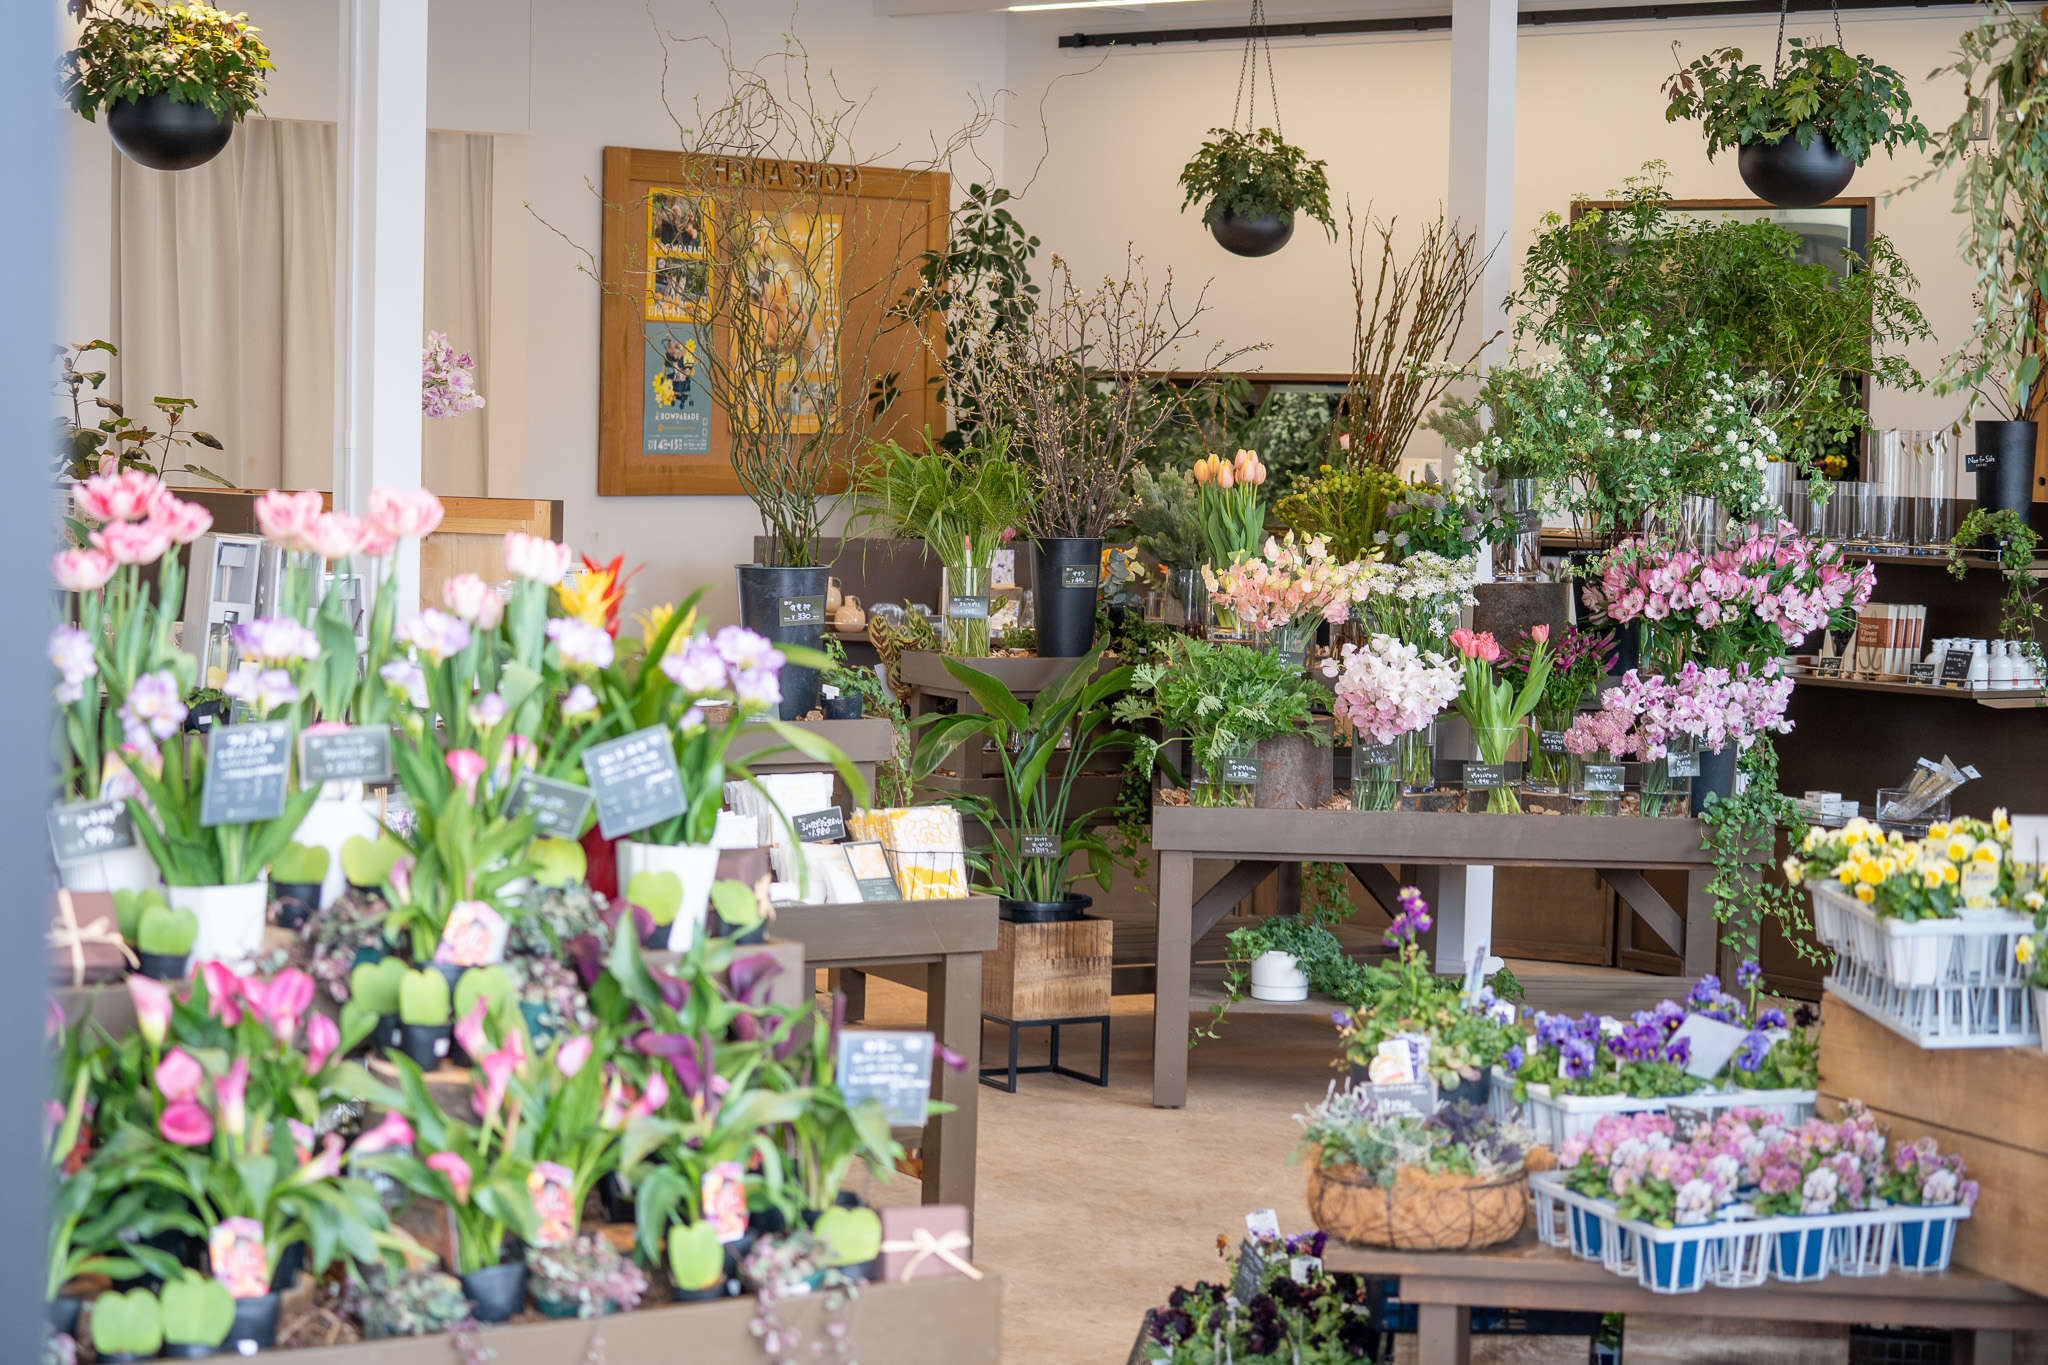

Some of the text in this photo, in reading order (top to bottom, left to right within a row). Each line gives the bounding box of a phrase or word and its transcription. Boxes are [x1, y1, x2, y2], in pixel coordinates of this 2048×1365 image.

[793, 163, 858, 191] SHOP
[660, 412, 700, 421] BOWPARADE
[1860, 629, 1878, 637] Flower
